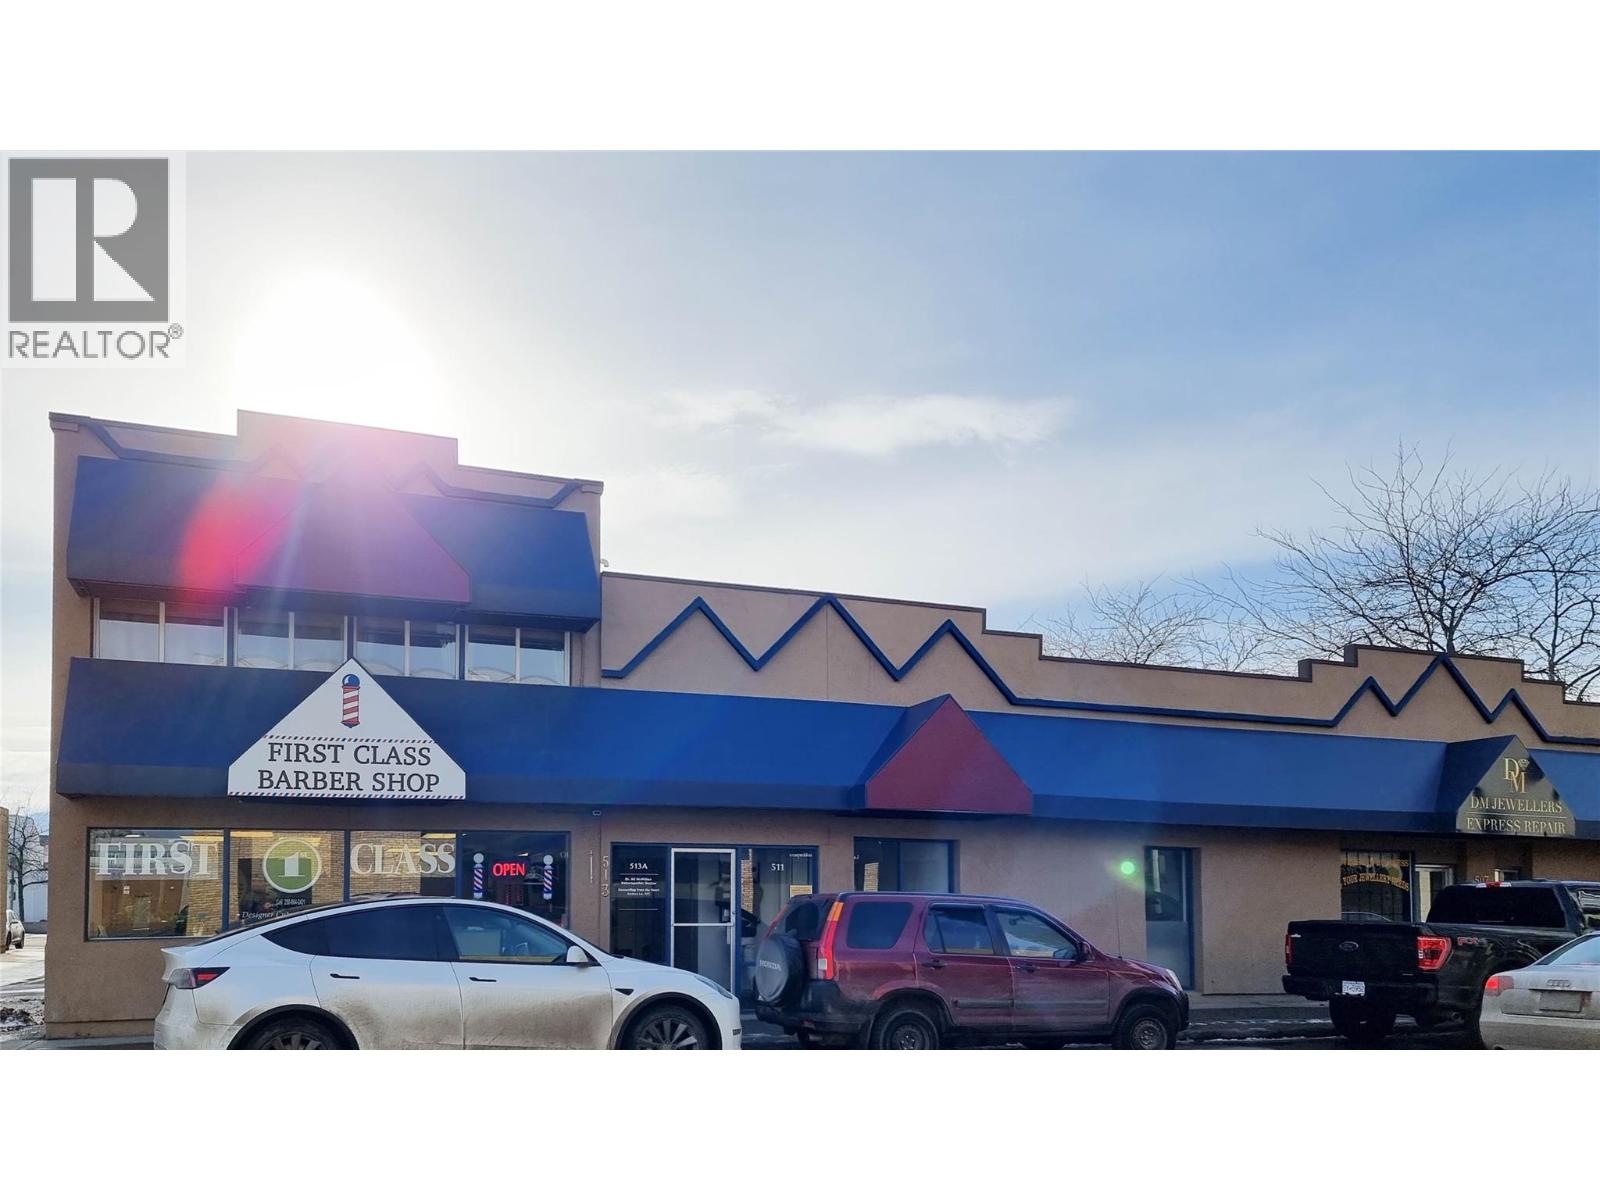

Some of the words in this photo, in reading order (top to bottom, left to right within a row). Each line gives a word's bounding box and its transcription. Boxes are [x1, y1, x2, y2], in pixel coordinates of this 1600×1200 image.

[268, 742, 344, 764] FIRST
[353, 745, 431, 766] CLASS
[257, 769, 363, 792] BARBER
[372, 772, 440, 793] SHOP
[1471, 796, 1489, 810] DM
[1491, 797, 1563, 813] JEWELLERS
[1467, 817, 1521, 832] EXPRESS
[1524, 821, 1567, 834] REPAIR
[96, 840, 219, 876] FIRST
[350, 843, 456, 875] CLASS
[629, 862, 648, 870] 513A
[492, 862, 526, 877] OPEN
[770, 863, 785, 871] 511
[242, 911, 274, 919] Designer
[759, 959, 782, 971] HONDA
